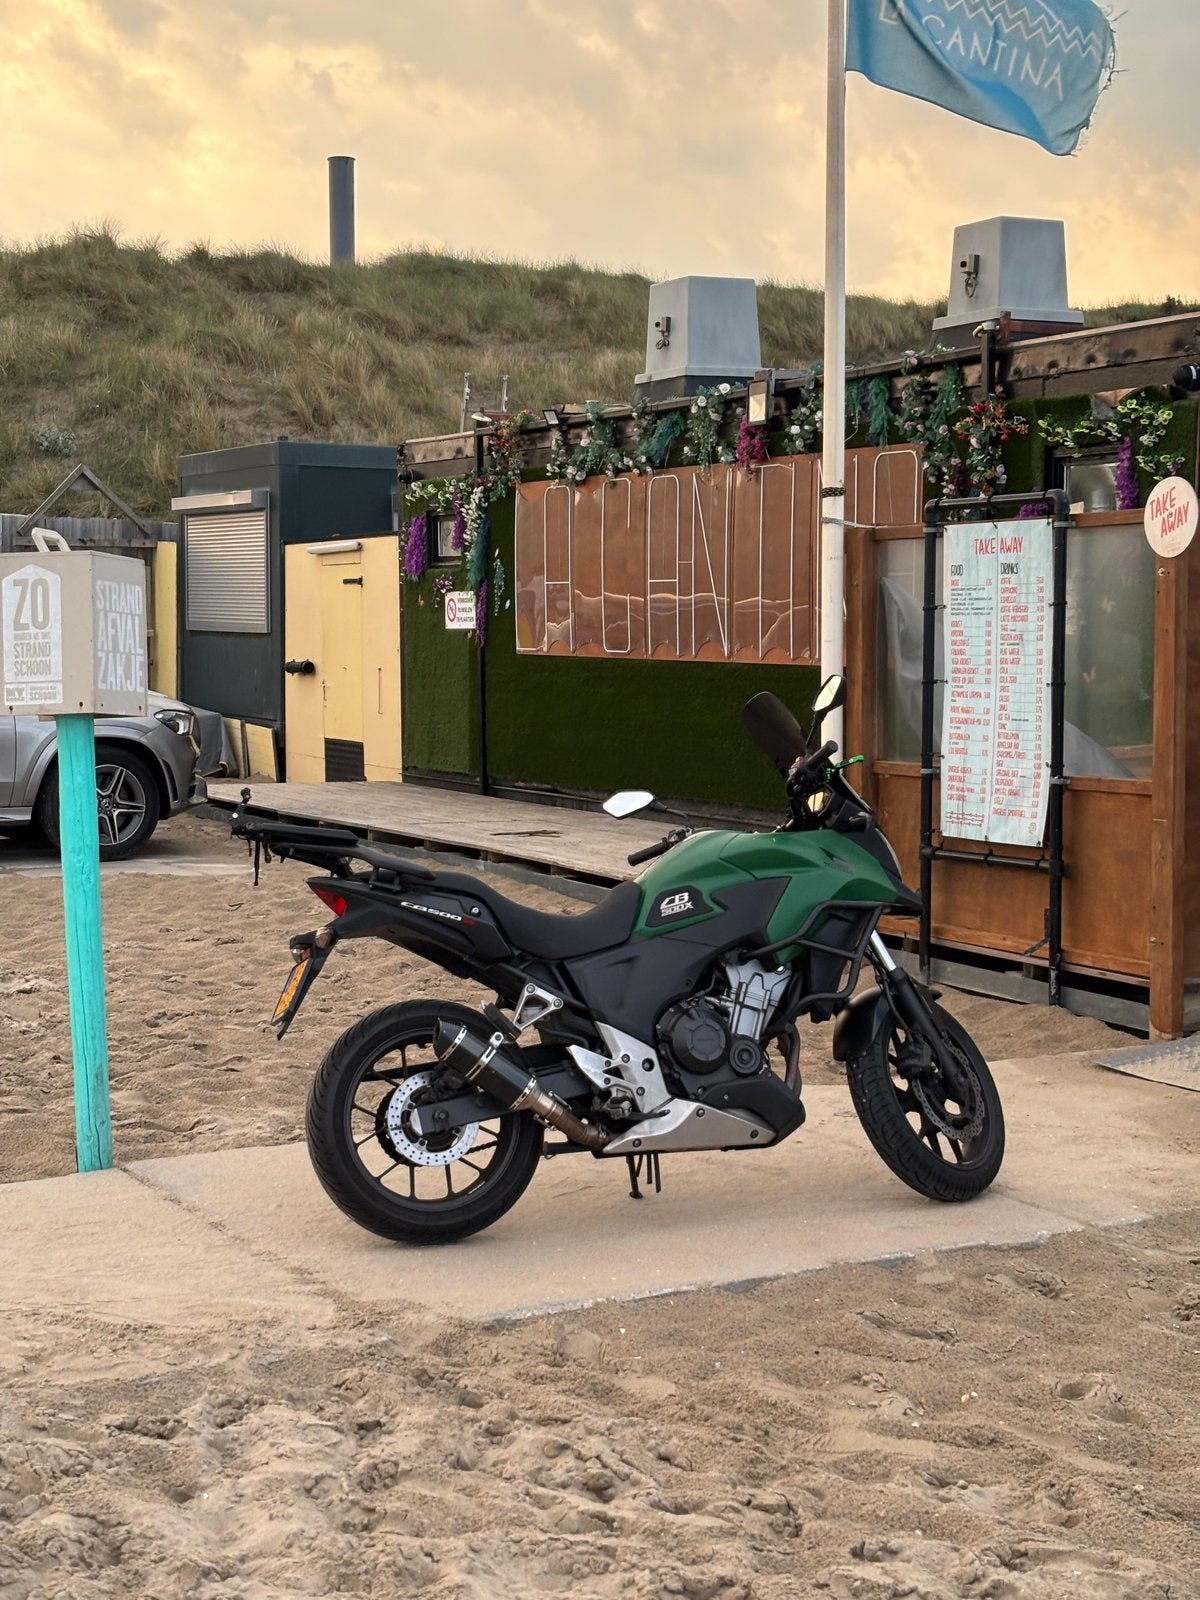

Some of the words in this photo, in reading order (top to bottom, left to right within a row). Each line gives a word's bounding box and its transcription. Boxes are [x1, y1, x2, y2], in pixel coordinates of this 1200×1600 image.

[921, 13, 1064, 102] CANTINA
[1149, 486, 1177, 521] TAKE
[1160, 500, 1190, 538] AWAY
[974, 537, 996, 556] TAKE
[999, 536, 1023, 554] AWAY
[950, 564, 964, 577] FOOD
[1000, 562, 1019, 575] DRINKS
[12, 577, 51, 631] ZO
[95, 579, 143, 615] STRAND
[96, 610, 145, 655] AFVAL
[14, 641, 51, 660] STRAND
[14, 659, 51, 677] SCHOON
[97, 650, 145, 693] ZAKJE
[659, 891, 690, 909] CB
[660, 900, 695, 917] 500X
